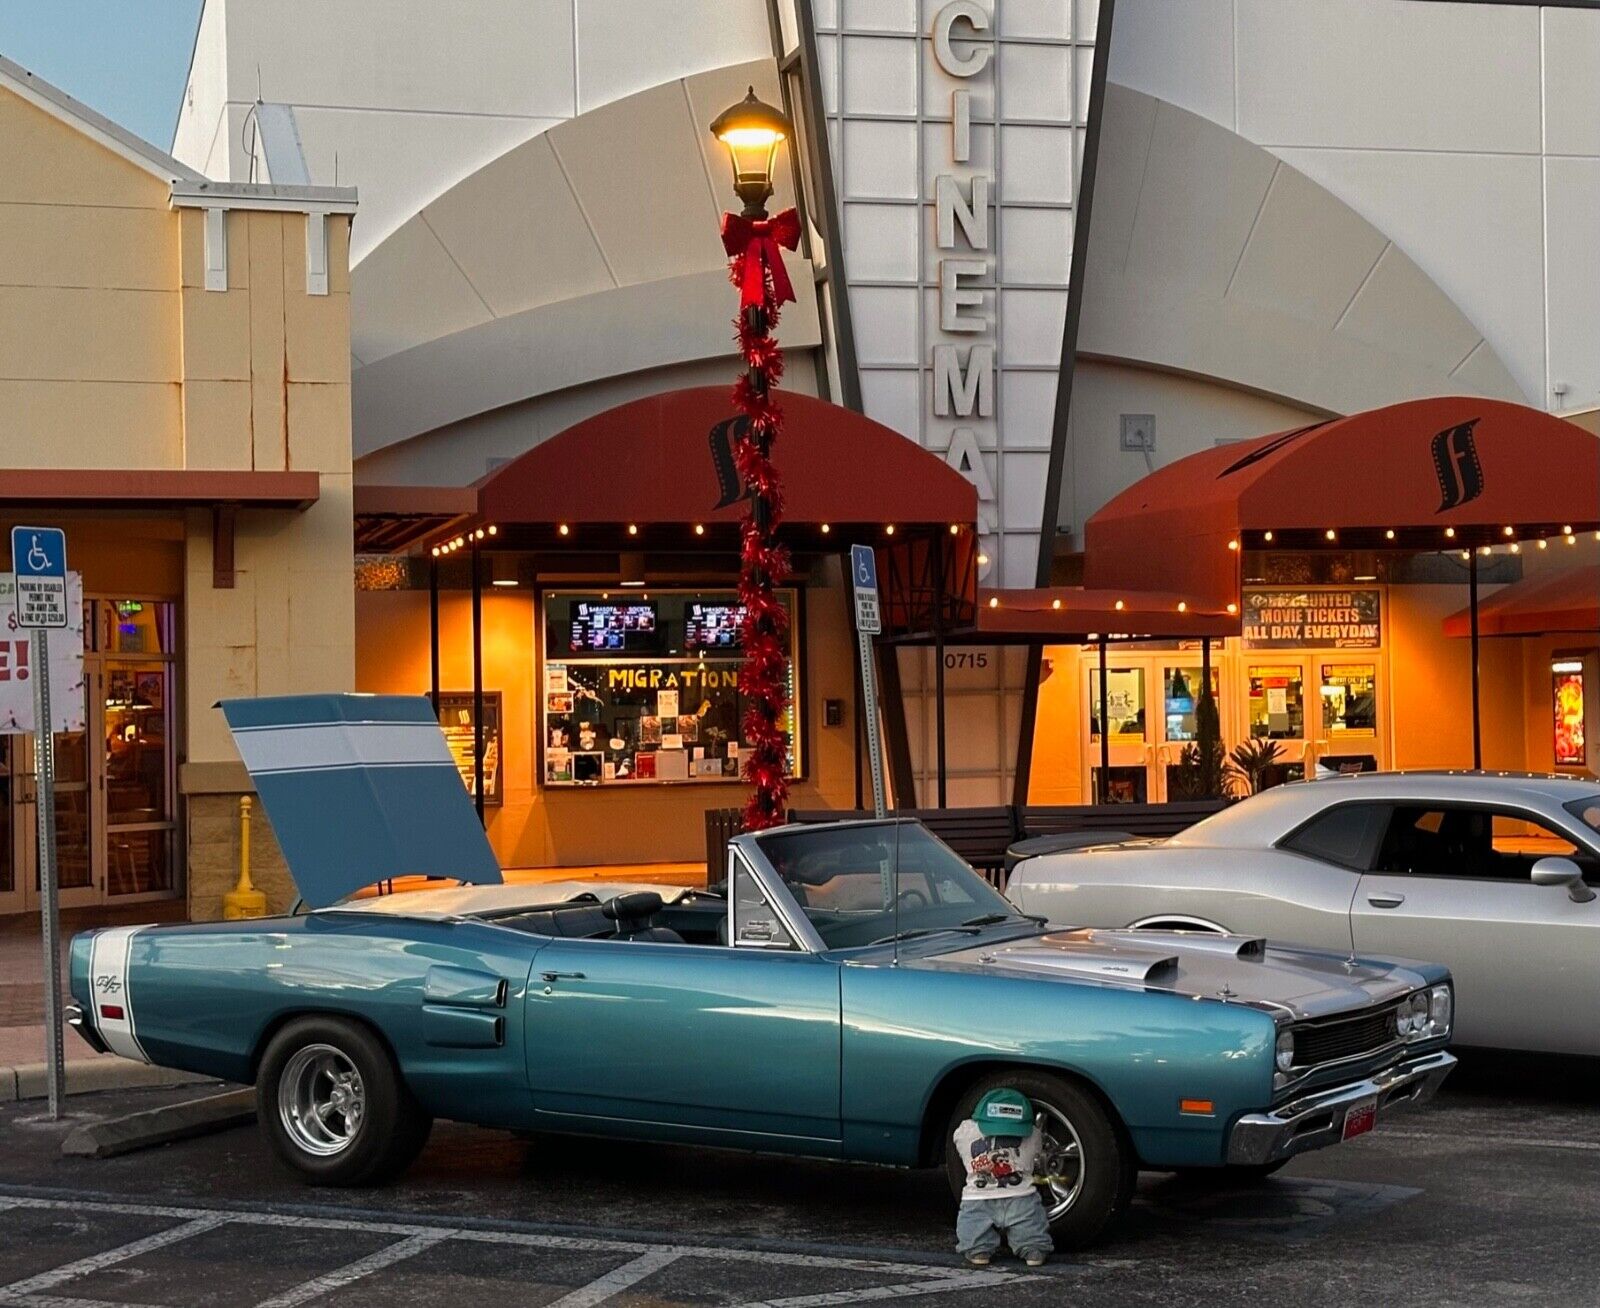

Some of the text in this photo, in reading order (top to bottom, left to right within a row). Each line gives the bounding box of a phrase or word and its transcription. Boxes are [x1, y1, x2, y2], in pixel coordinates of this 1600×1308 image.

[932, 0, 995, 581] CINEMA
[20, 583, 37, 592] PARKING
[43, 583, 63, 592] DISABLED
[29, 593, 54, 603] PERMIT ONLY
[48, 603, 59, 612] ZONE
[25, 612, 34, 622] FINE
[1260, 608, 1360, 623] MOVIE TICKETS
[1243, 624, 1378, 640] ALL DAY, EVERYDAY
[945, 653, 988, 669] 0715
[608, 669, 738, 689] MIGRATION
[96, 975, 122, 993] R/T
